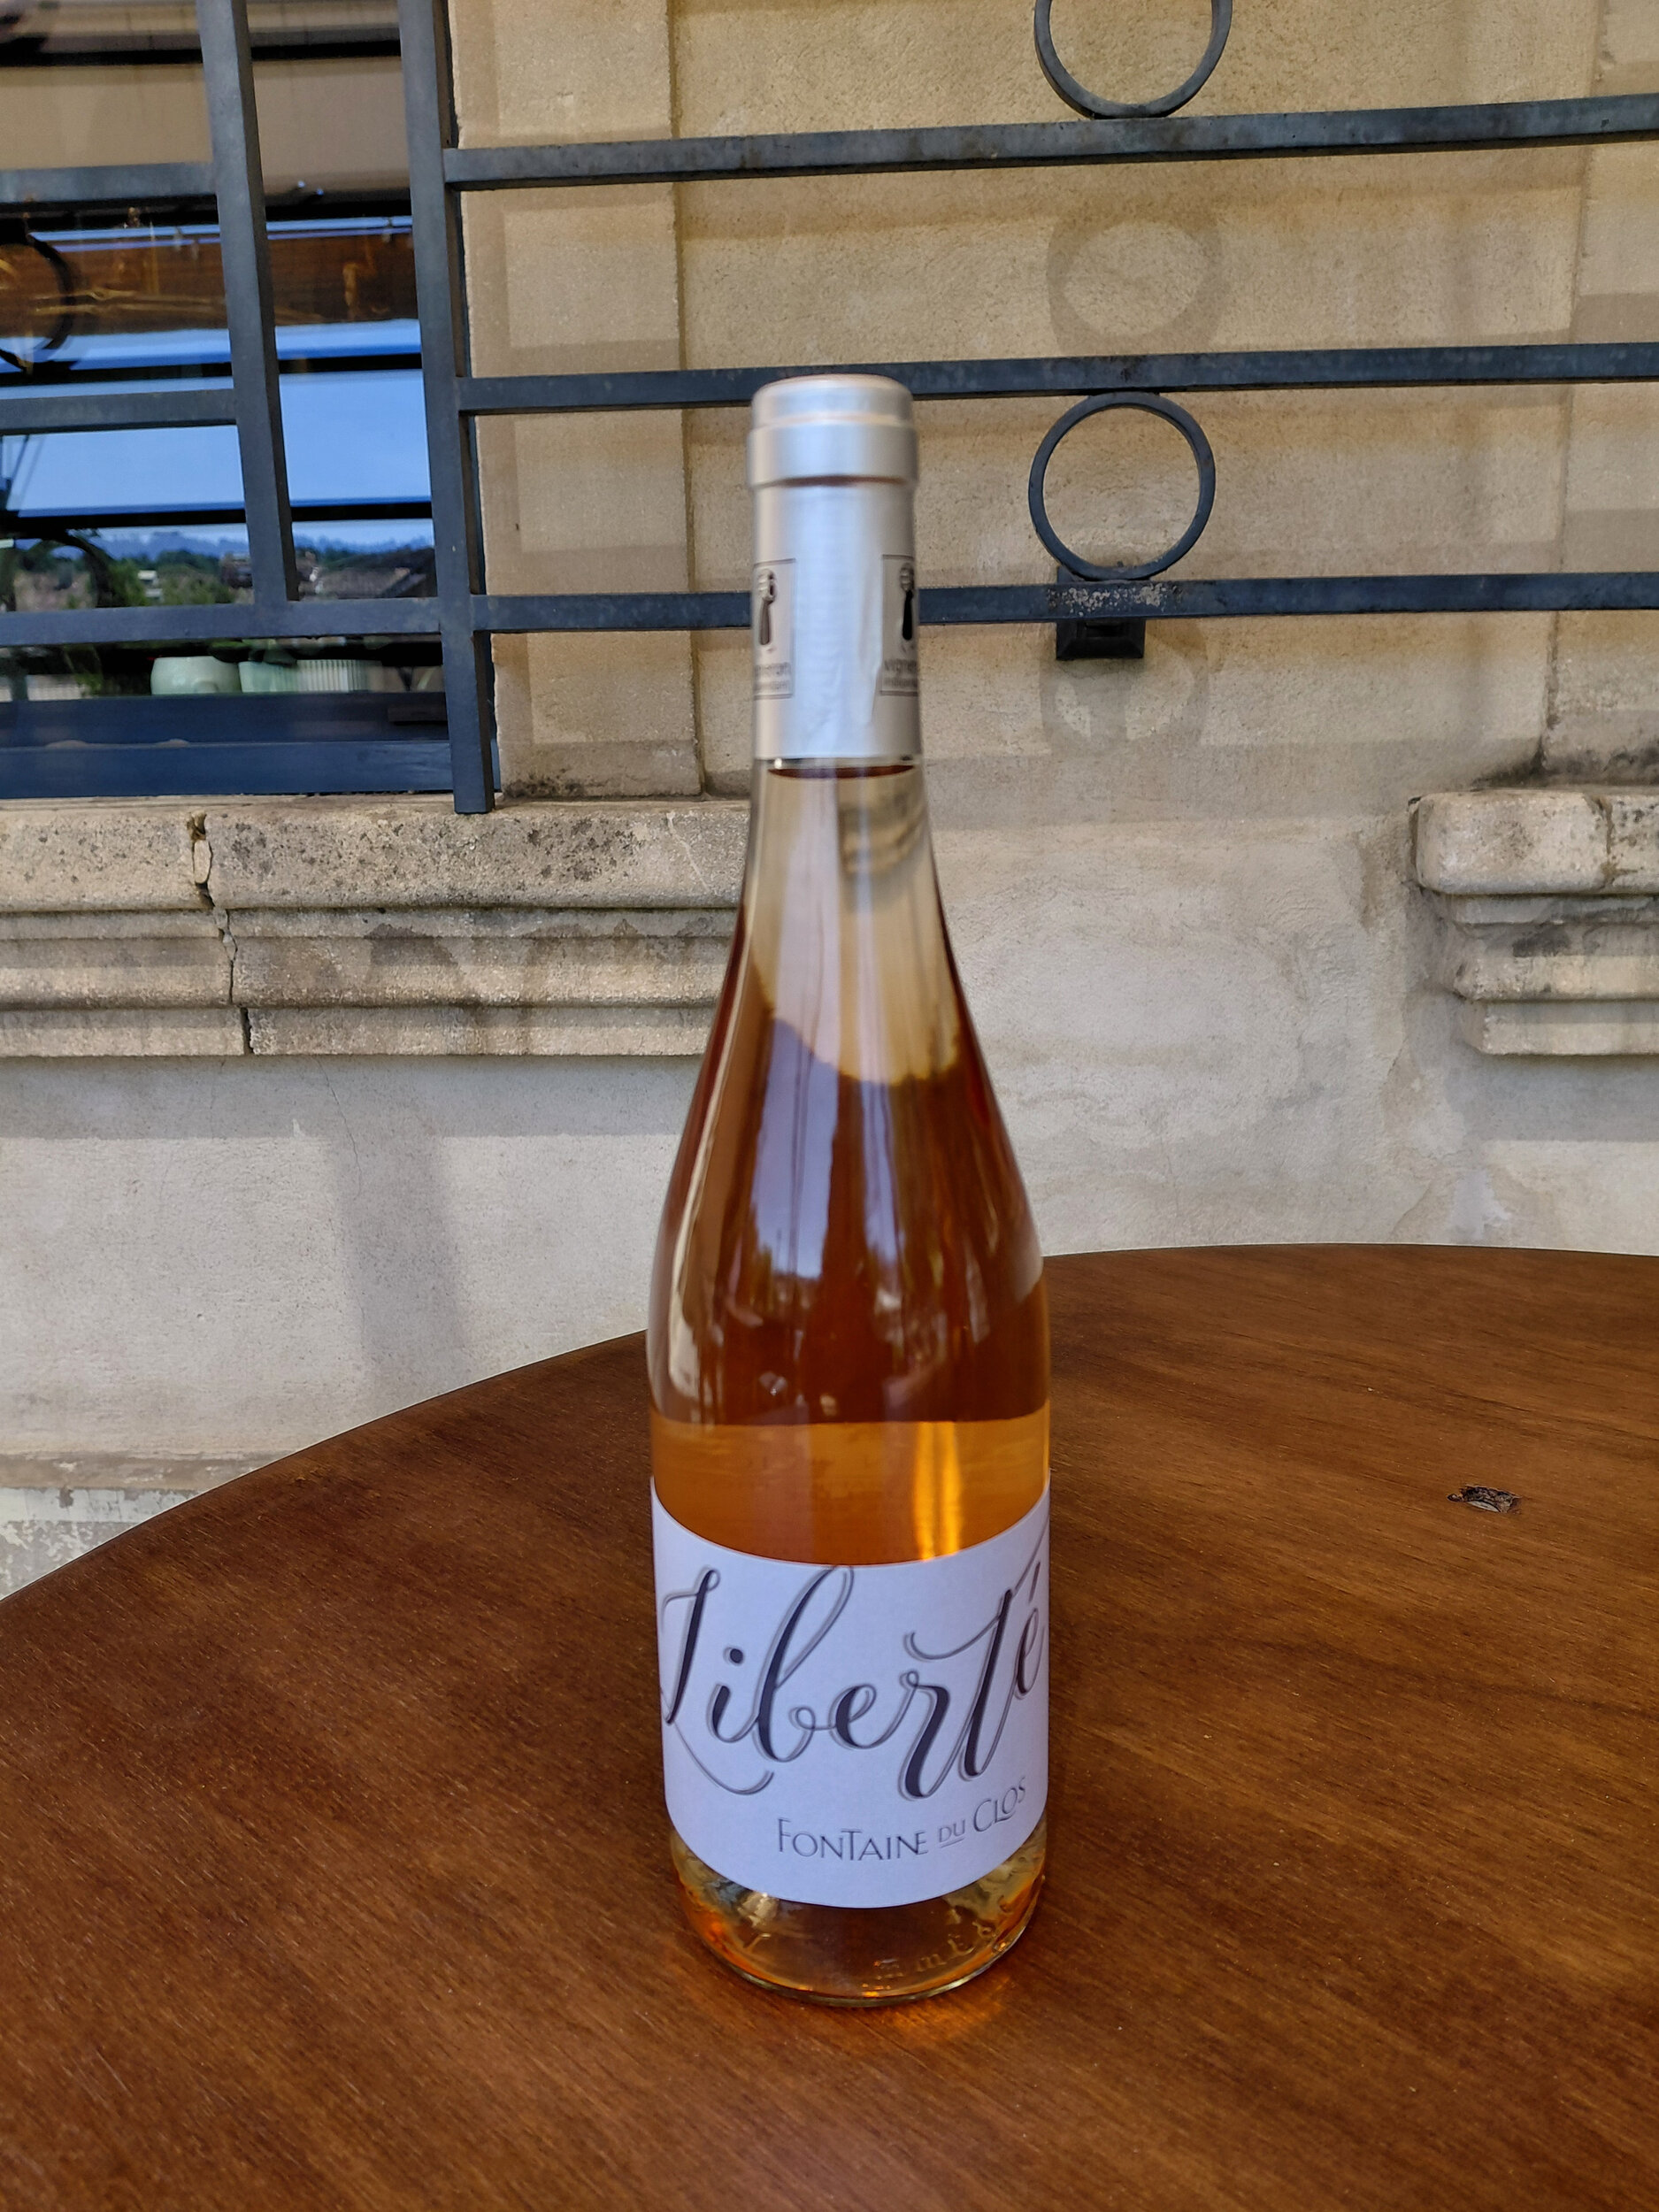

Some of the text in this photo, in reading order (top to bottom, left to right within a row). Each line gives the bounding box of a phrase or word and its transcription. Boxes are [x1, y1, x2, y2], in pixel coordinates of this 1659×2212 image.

[659, 1515, 1049, 1801] Liberté
[778, 1775, 1027, 1861] FONTAINE DU CLOS
